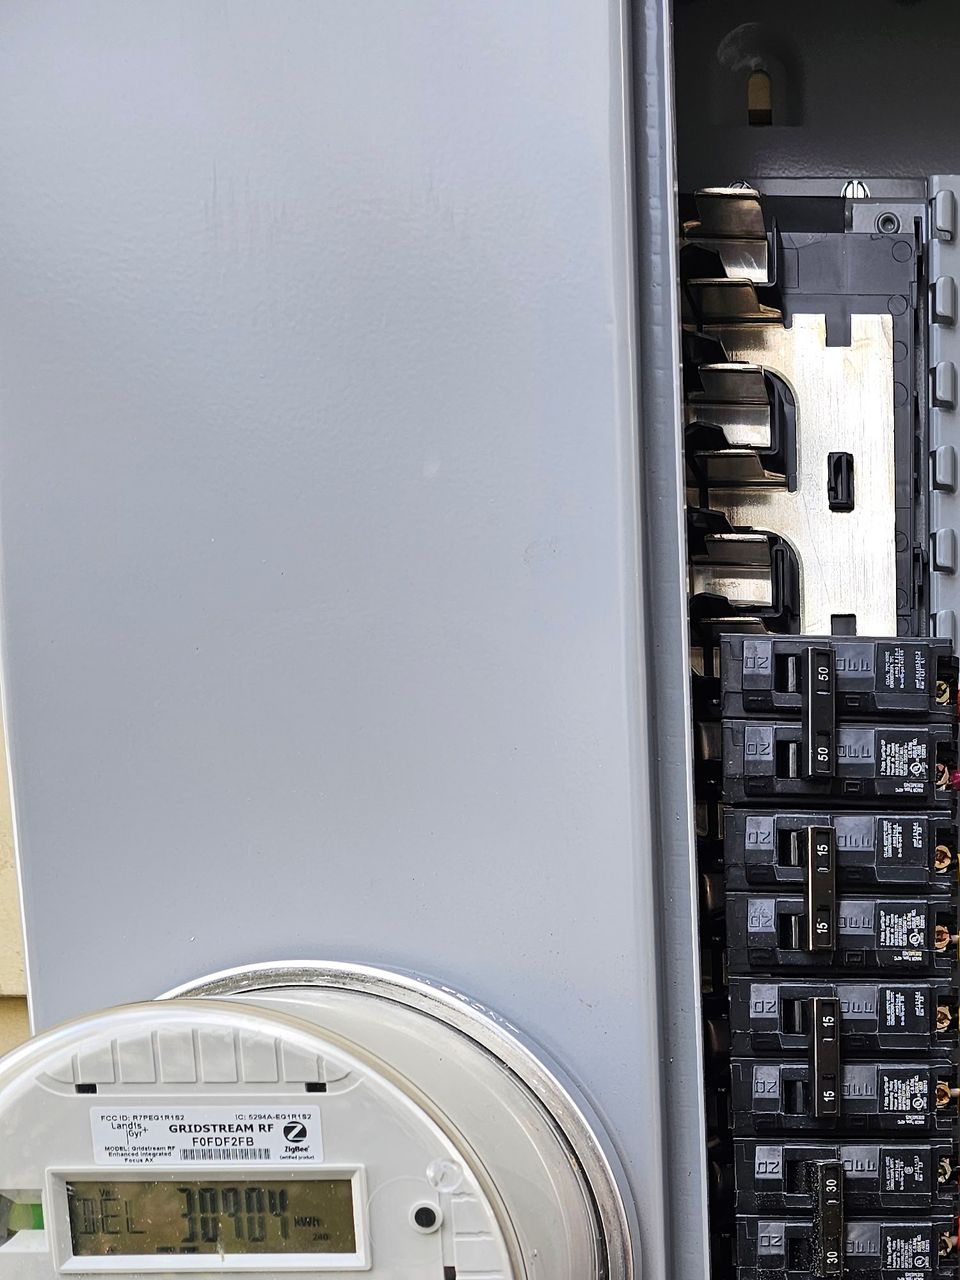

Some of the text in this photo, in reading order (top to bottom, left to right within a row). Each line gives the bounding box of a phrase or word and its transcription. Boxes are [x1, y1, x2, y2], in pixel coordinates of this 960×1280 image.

[745, 656, 768, 669] ON
[836, 657, 872, 671] OFF
[818, 666, 829, 681] 50
[746, 742, 770, 756] ON
[817, 746, 829, 762] 50
[837, 744, 872, 758] OFF
[748, 831, 771, 844] ON
[838, 835, 872, 848] OFF
[816, 844, 829, 856] 15
[751, 915, 773, 928] ON
[816, 921, 828, 934] 15
[838, 916, 872, 929] OFF
[753, 1001, 777, 1014] ON
[841, 1001, 874, 1014] OFF
[822, 1015, 835, 1028] 15
[755, 1081, 777, 1094] ON
[841, 1083, 875, 1096] OFF
[823, 1090, 835, 1102] 15
[111, 1121, 142, 1130] Landis
[169, 1123, 274, 1134] GRIDSTREAM RF
[192, 1136, 254, 1147] F0FDF2FB
[285, 1145, 309, 1154] ZigBee
[756, 1160, 780, 1175] ON
[844, 1158, 877, 1172] OFF
[825, 1179, 837, 1193] 30
[79, 1199, 146, 1235] DEL
[294, 1216, 320, 1228] kWh
[759, 1234, 783, 1247] ON
[826, 1251, 838, 1264] 30
